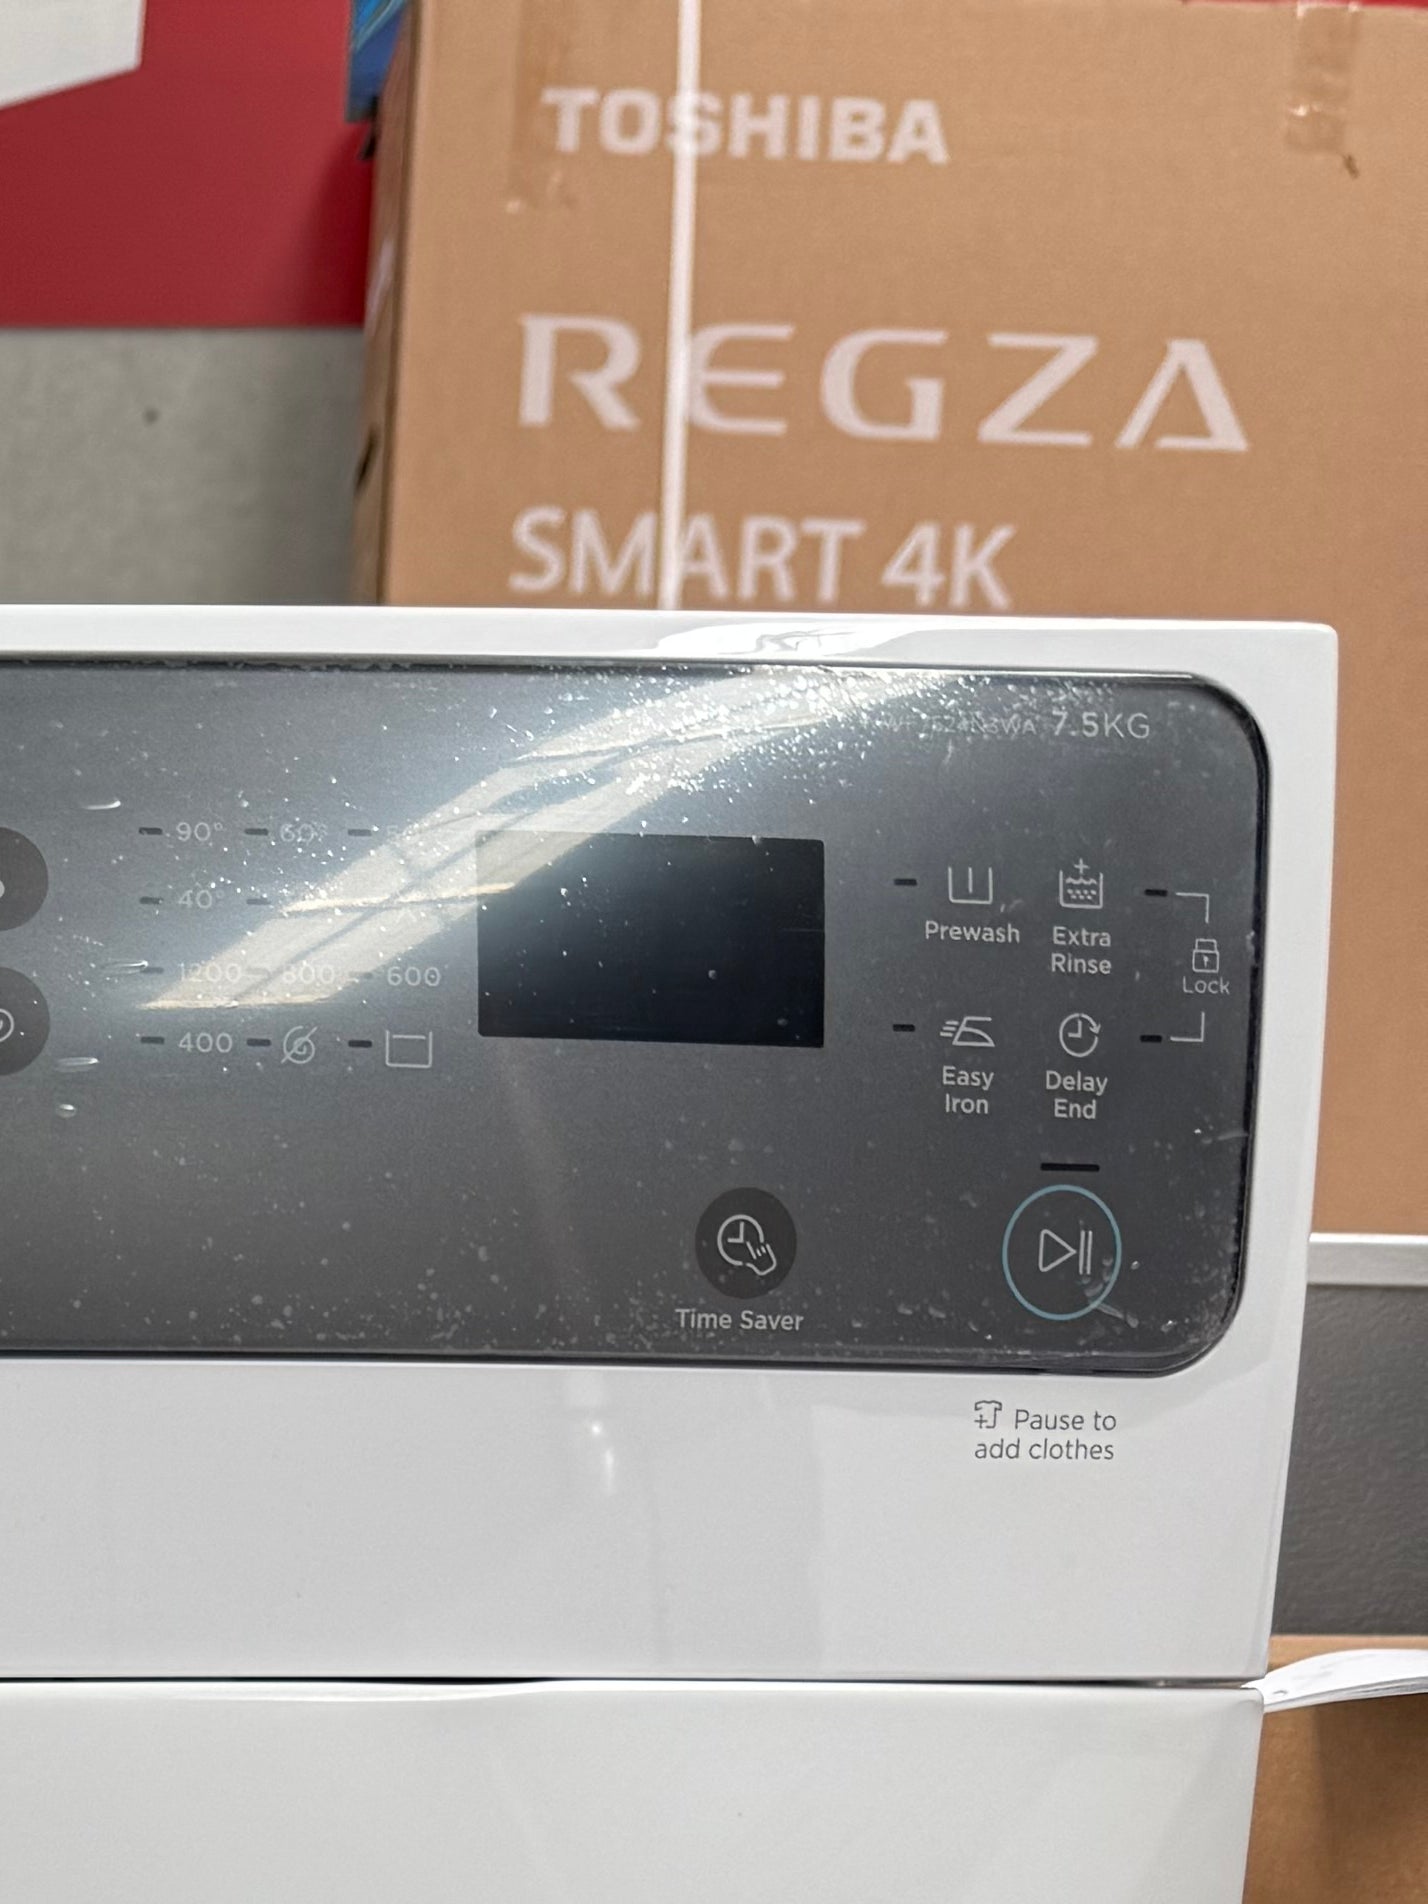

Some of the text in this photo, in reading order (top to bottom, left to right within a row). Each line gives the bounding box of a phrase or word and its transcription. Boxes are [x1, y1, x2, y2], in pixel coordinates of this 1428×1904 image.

[542, 88, 949, 163] TOSHIBA
[518, 314, 1249, 450] REGZA
[510, 508, 1015, 610] SMART 4K
[1051, 712, 1151, 741] 7.5KG
[925, 921, 1020, 943] Prewash
[1053, 927, 1111, 946] Extra
[1051, 954, 1111, 975] Rinse
[387, 966, 440, 986] 600
[1183, 977, 1230, 994] Lock
[179, 1033, 232, 1053] 400
[942, 1066, 994, 1089] Easy
[1046, 1071, 1107, 1095] Delay
[945, 1094, 988, 1114] Iron
[1054, 1099, 1096, 1119] End
[676, 1309, 803, 1331] Time Saver
[1014, 1409, 1117, 1432] Pause to
[974, 1438, 1115, 1461] add clothes
